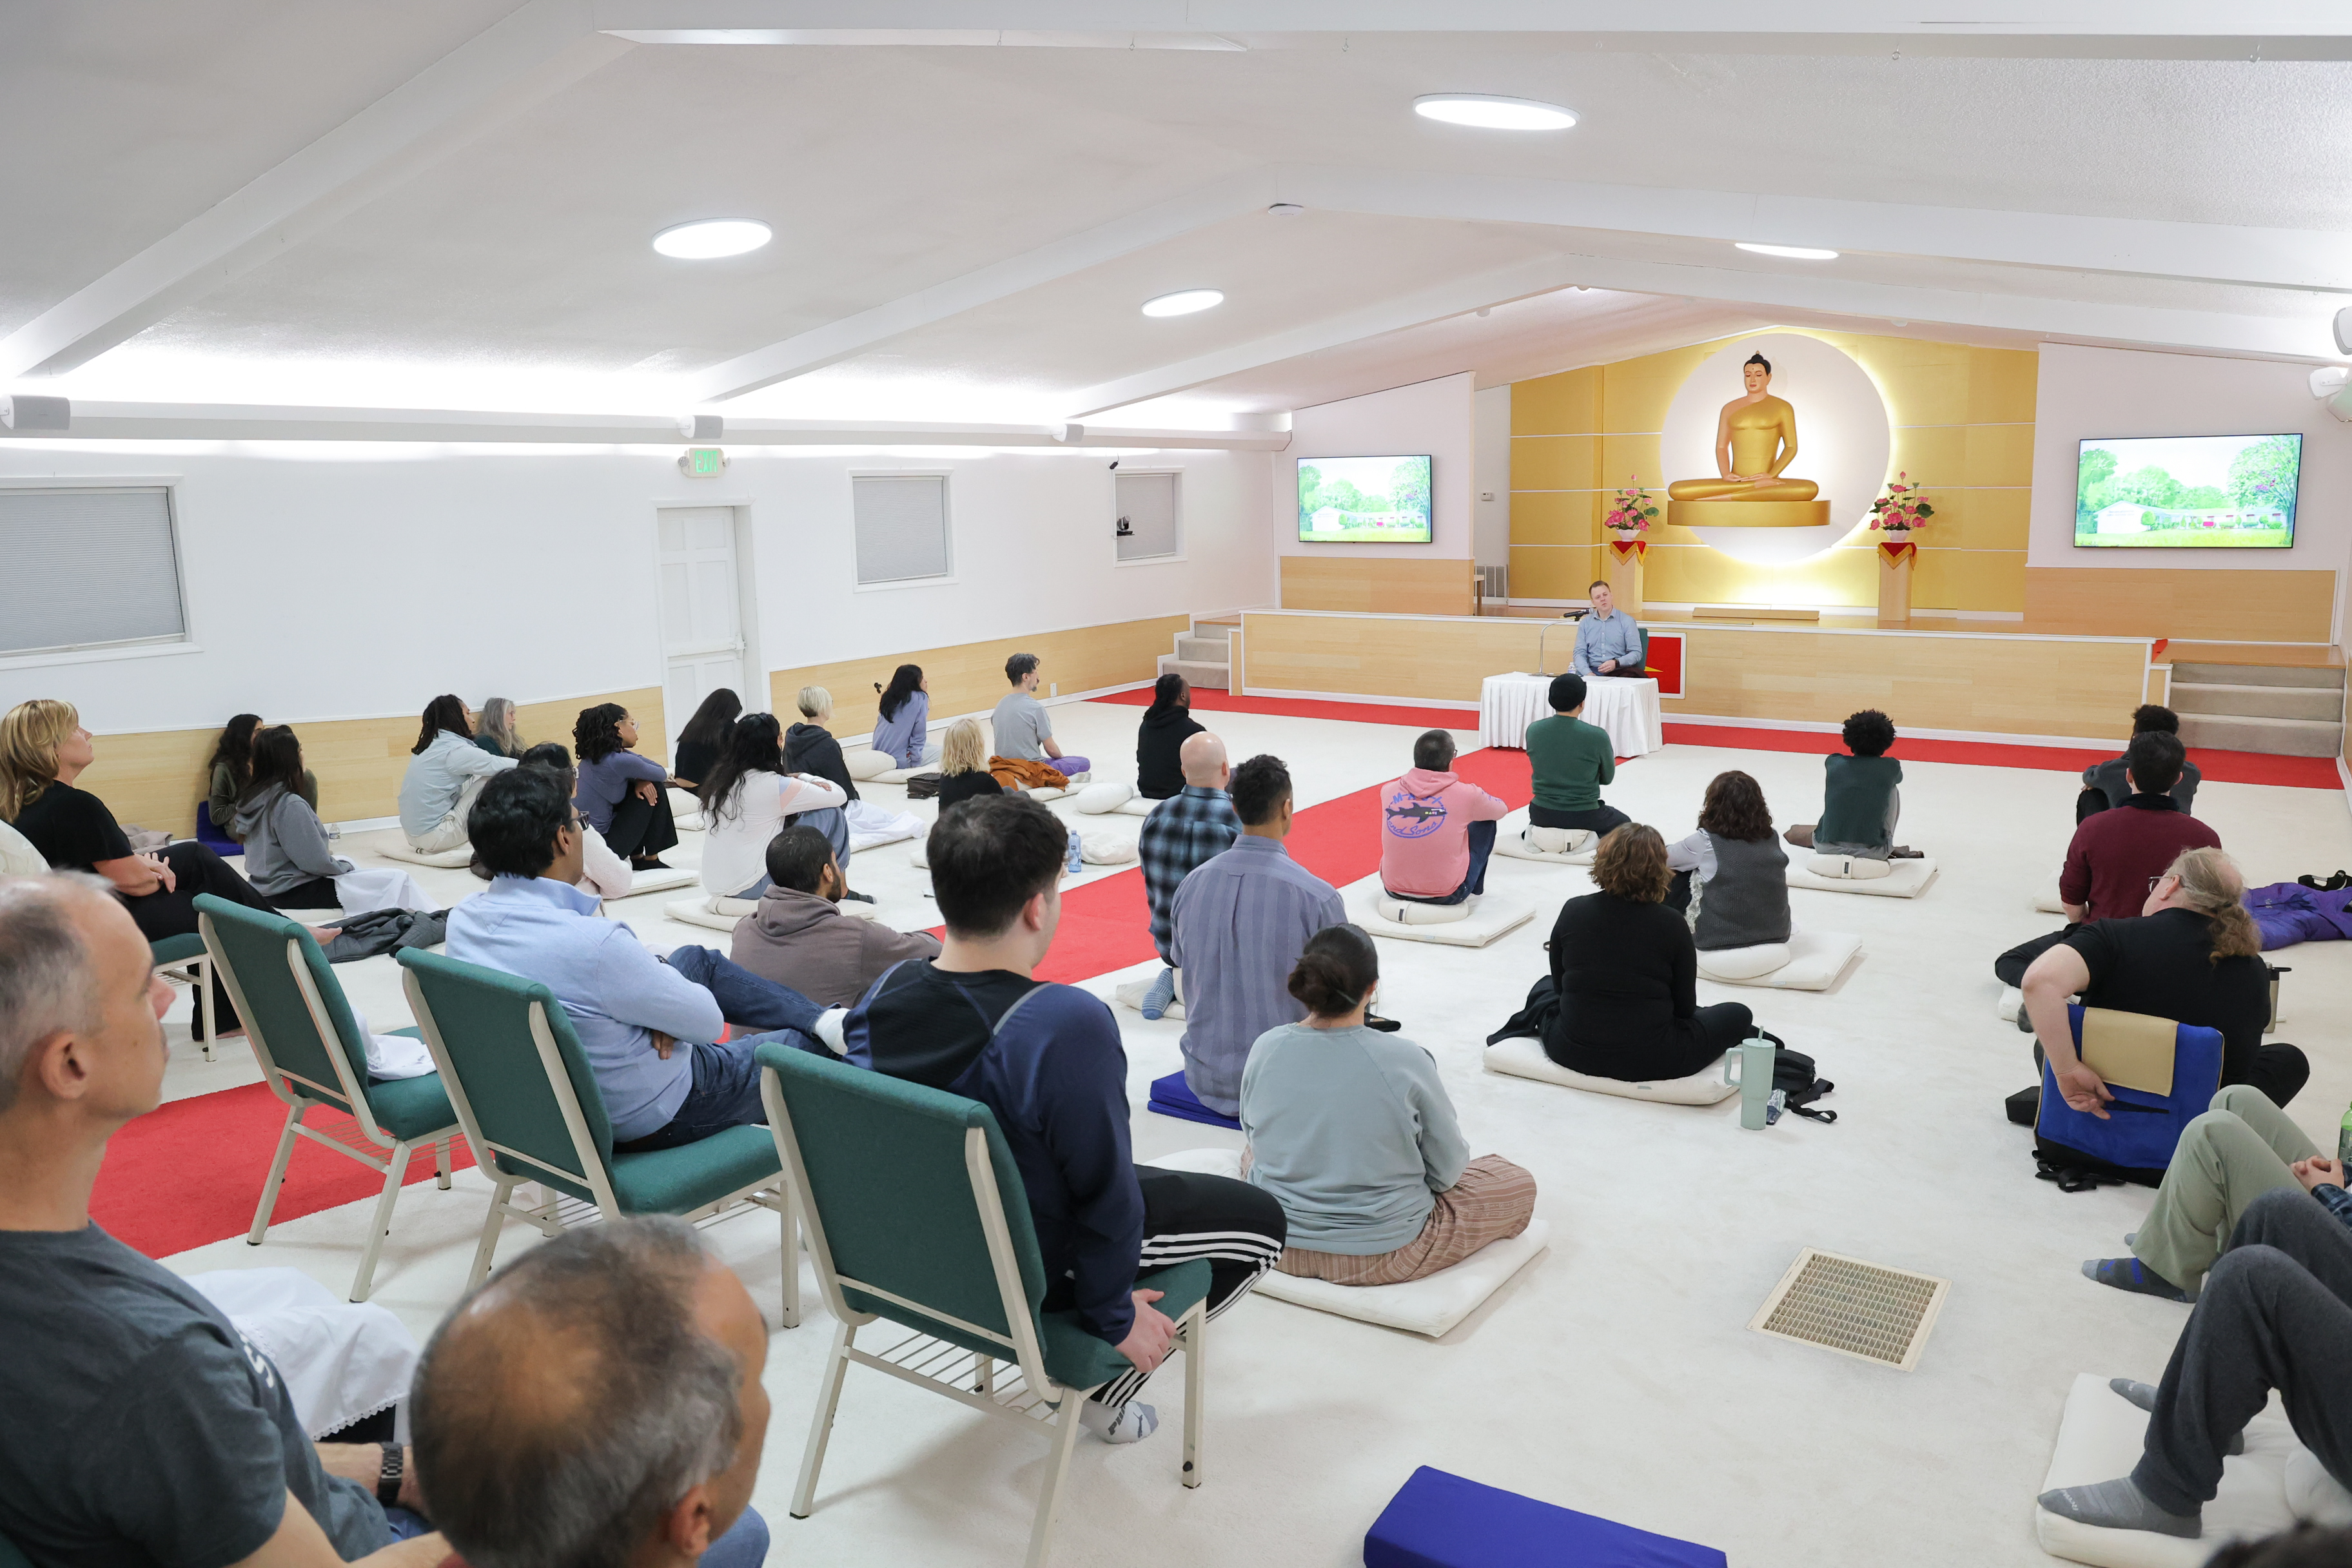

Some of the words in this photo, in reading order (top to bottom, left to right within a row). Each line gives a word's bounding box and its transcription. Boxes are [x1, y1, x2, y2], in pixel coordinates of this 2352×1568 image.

[695, 451, 718, 473] EXIT
[1388, 821, 1407, 834] and
[1409, 821, 1438, 835] Sons
